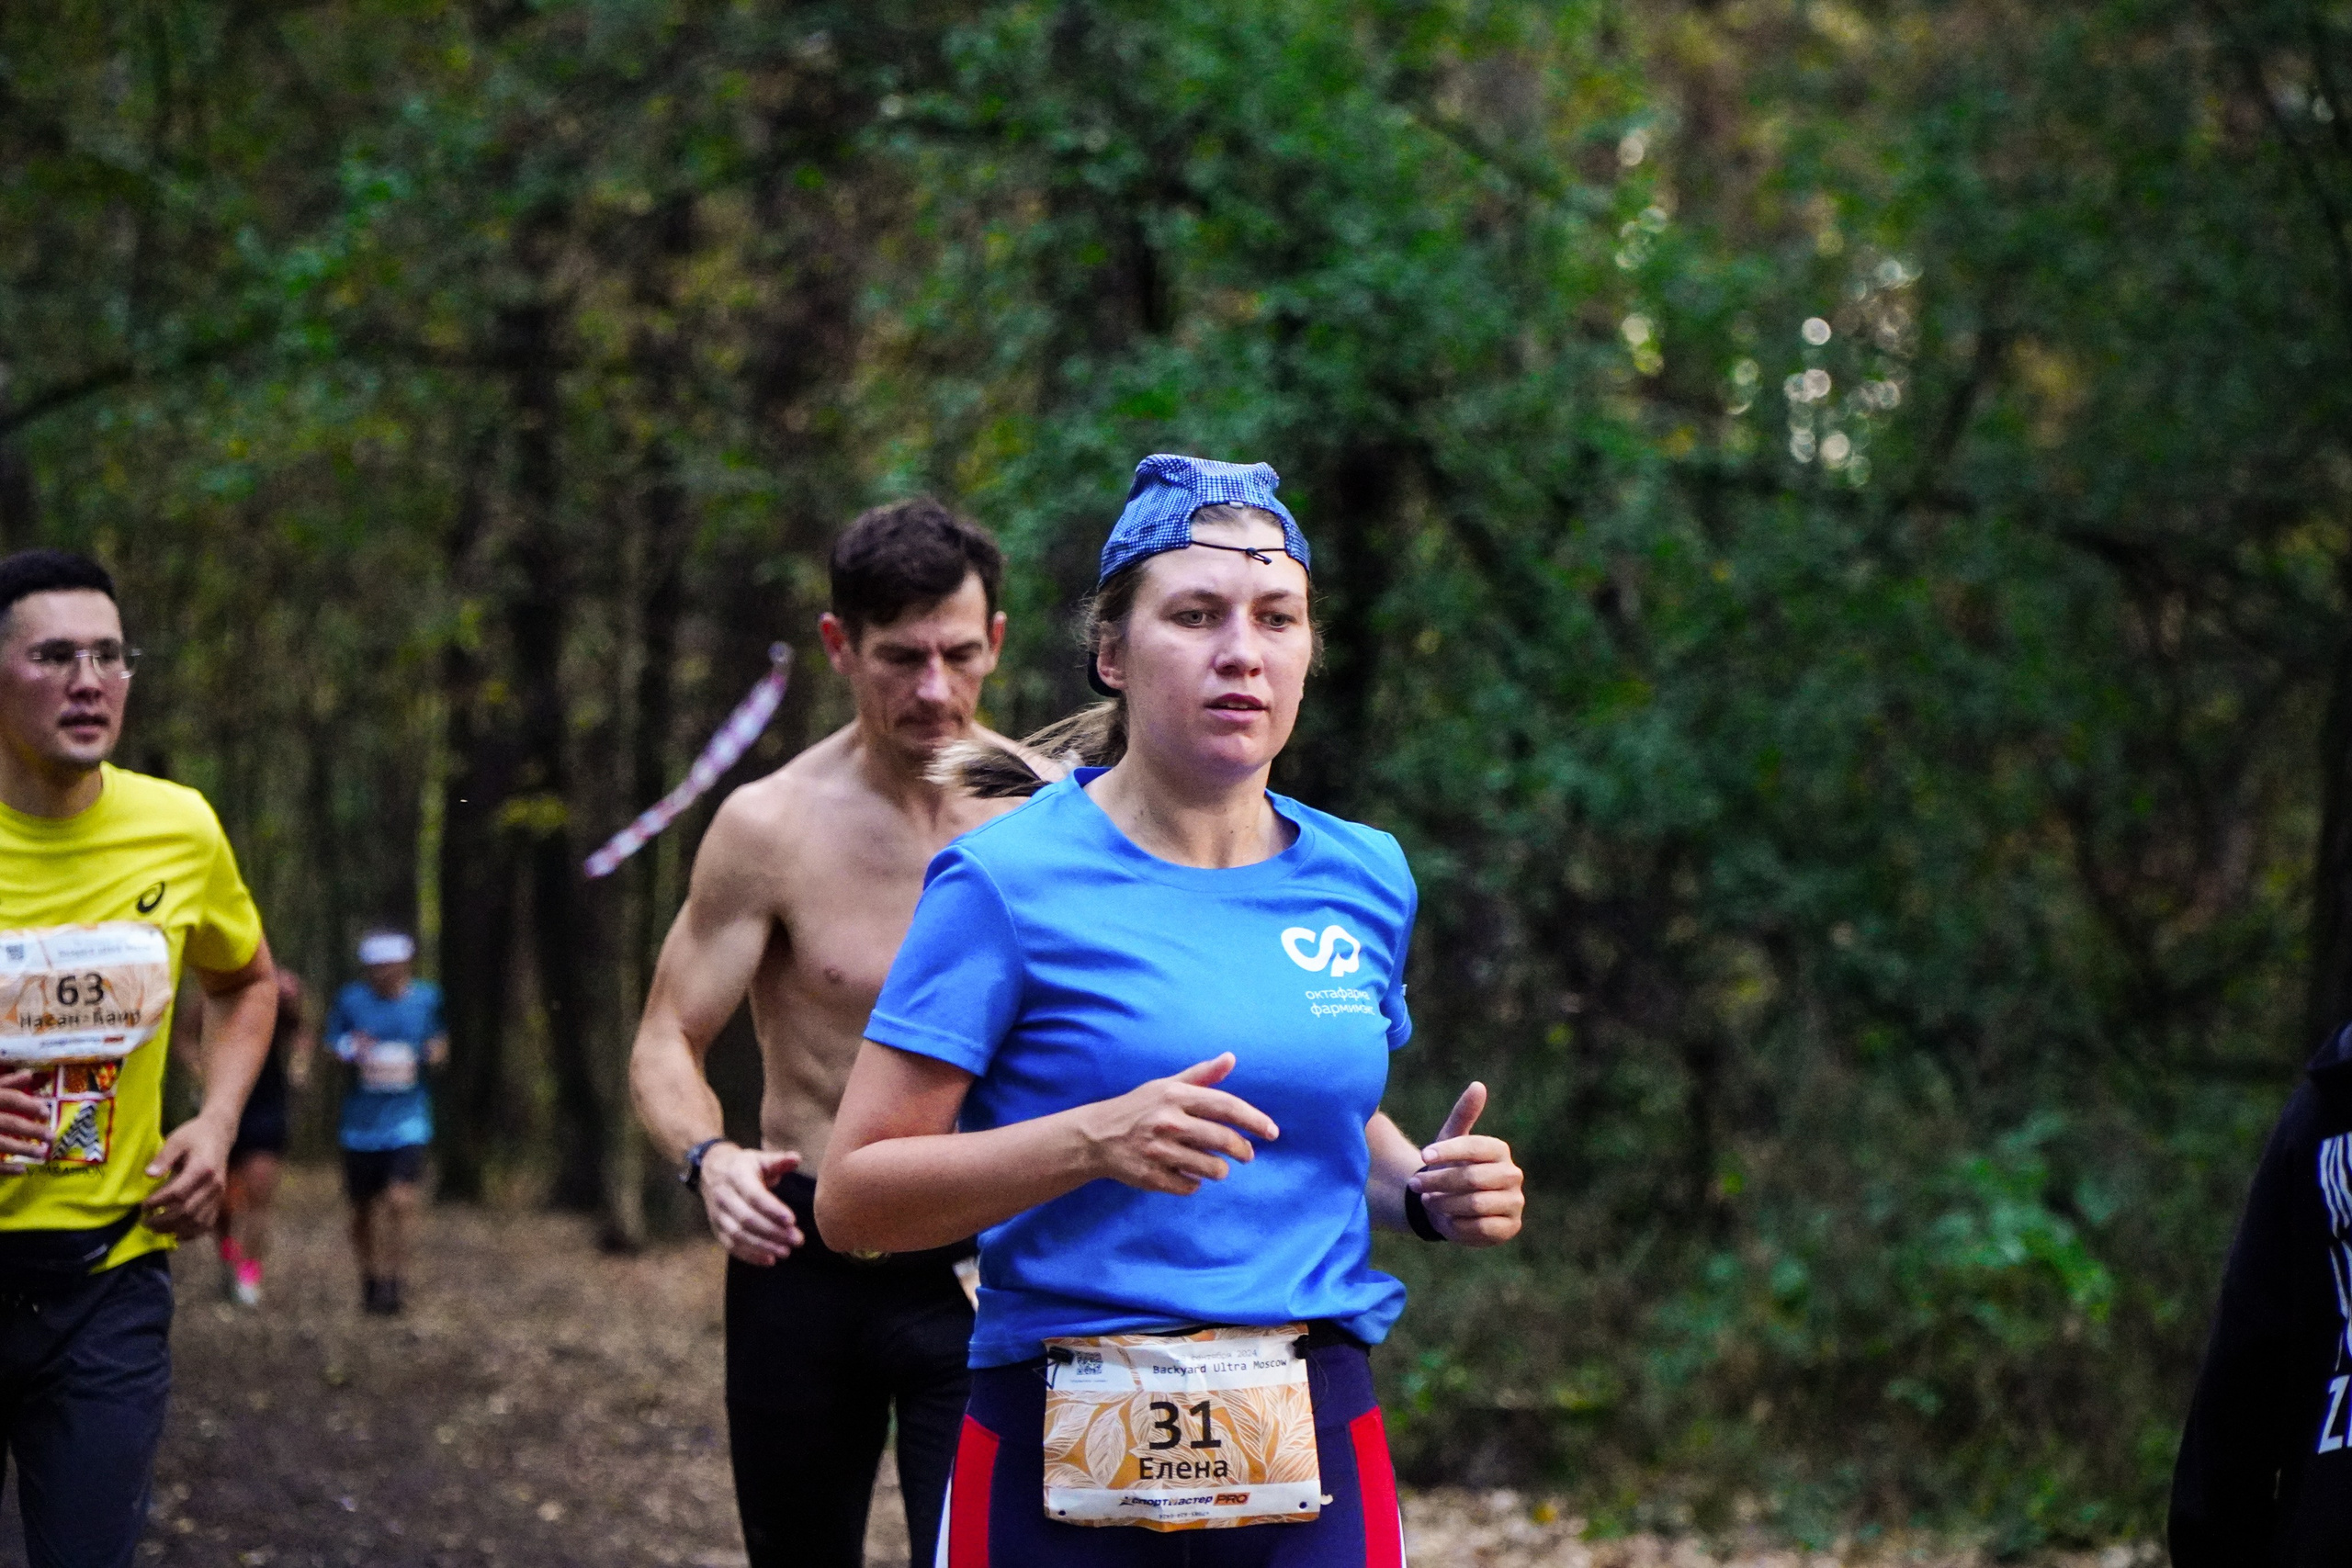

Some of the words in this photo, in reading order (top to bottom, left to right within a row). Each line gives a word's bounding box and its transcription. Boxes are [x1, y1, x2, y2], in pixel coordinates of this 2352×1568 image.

[56, 973, 106, 1007] 63
[1238, 1348, 1258, 1359] 2024
[1152, 1365, 1207, 1376] Backyard
[1213, 1362, 1247, 1372] Ultra
[1253, 1359, 1287, 1370] Moscow
[1148, 1400, 1222, 1450] 31
[1139, 1457, 1229, 1480] Елена
[1215, 1494, 1250, 1505] PRO
